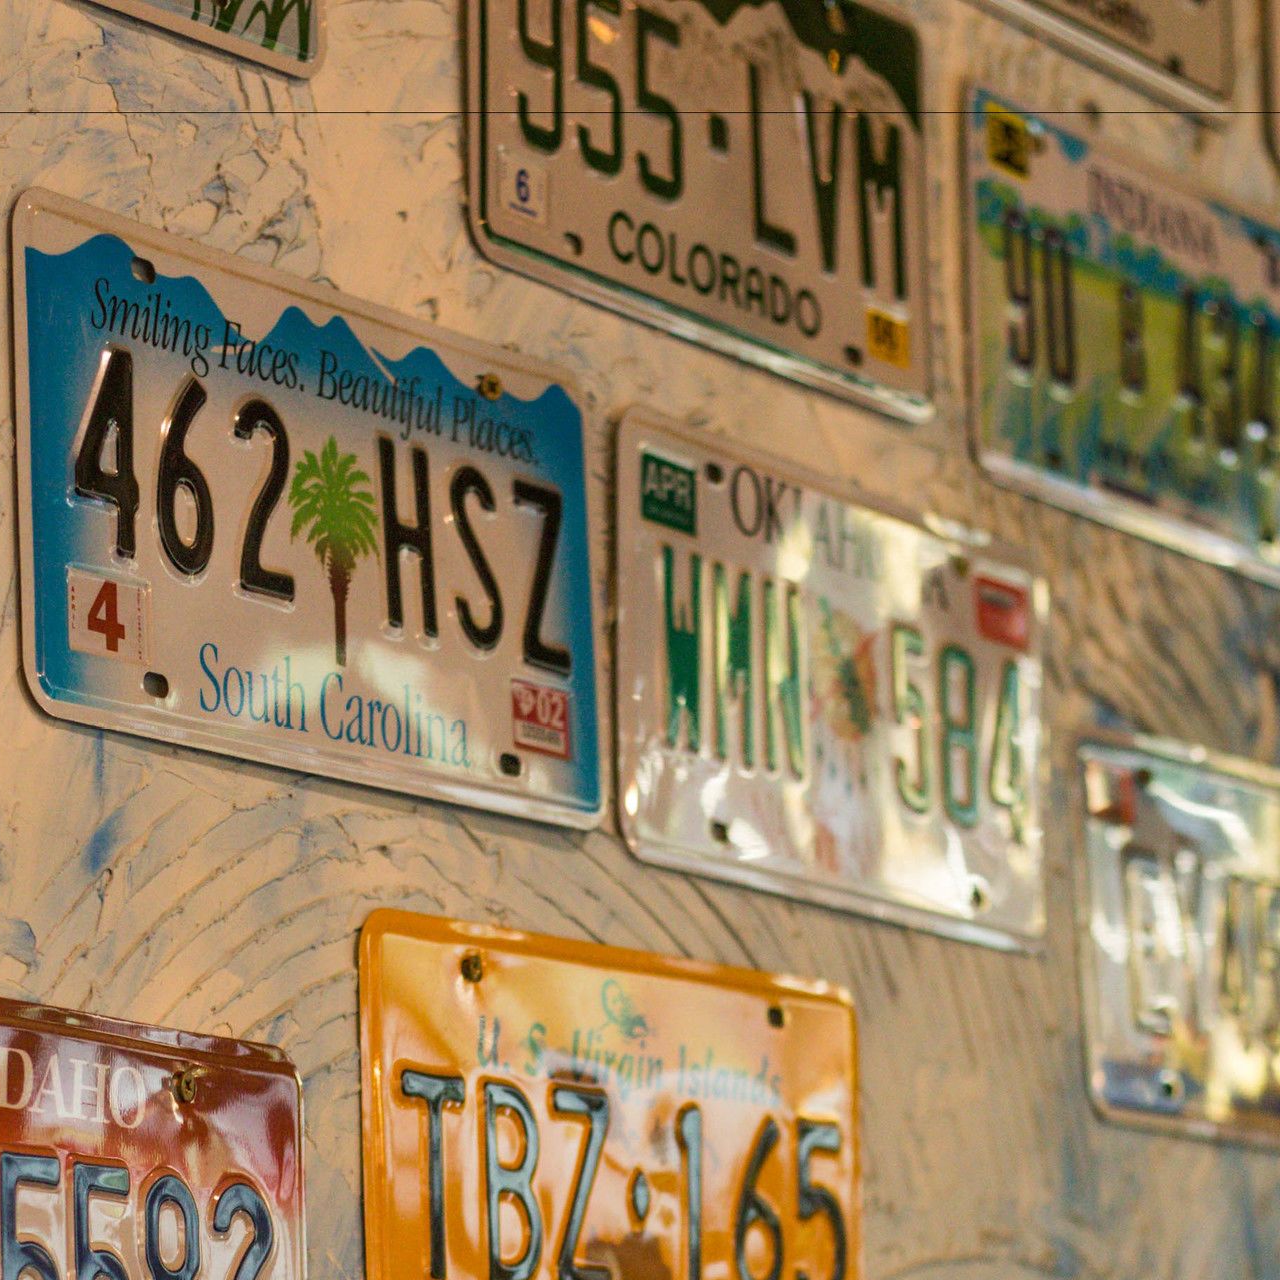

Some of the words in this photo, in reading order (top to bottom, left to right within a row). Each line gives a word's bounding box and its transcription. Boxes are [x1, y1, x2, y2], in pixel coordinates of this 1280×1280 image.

[607, 209, 822, 338] COLORADO
[89, 277, 213, 379] Smiling
[218, 320, 306, 393] Faces.
[316, 350, 444, 442] Beautiful
[452, 398, 541, 466] Places.
[72, 345, 297, 607] 462
[377, 432, 573, 672] HSZ
[87, 580, 126, 653] 4
[198, 641, 308, 734] South
[319, 671, 473, 769] Carolina
